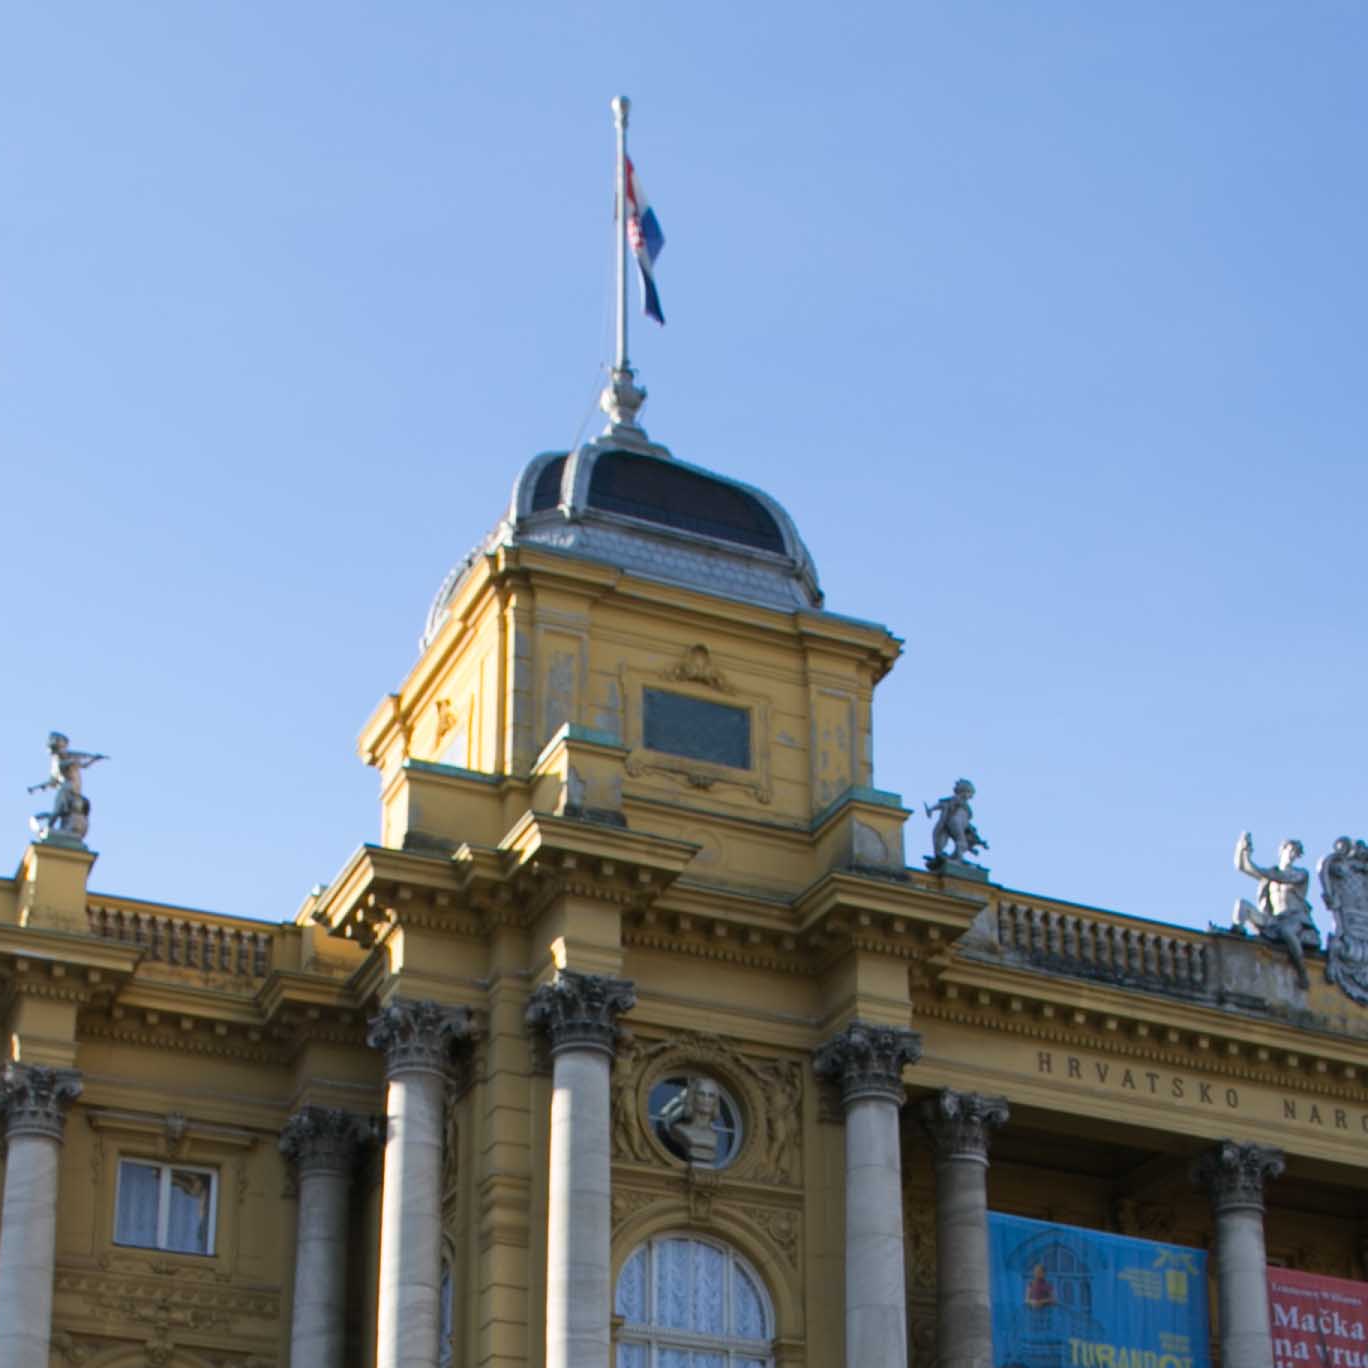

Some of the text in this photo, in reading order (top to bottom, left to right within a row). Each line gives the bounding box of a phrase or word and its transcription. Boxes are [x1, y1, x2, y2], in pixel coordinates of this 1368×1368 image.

[1037, 1052, 1239, 1108] HRVATSKO
[1273, 1303, 1366, 1341] Mačka
[1273, 1337, 1309, 1360] na
